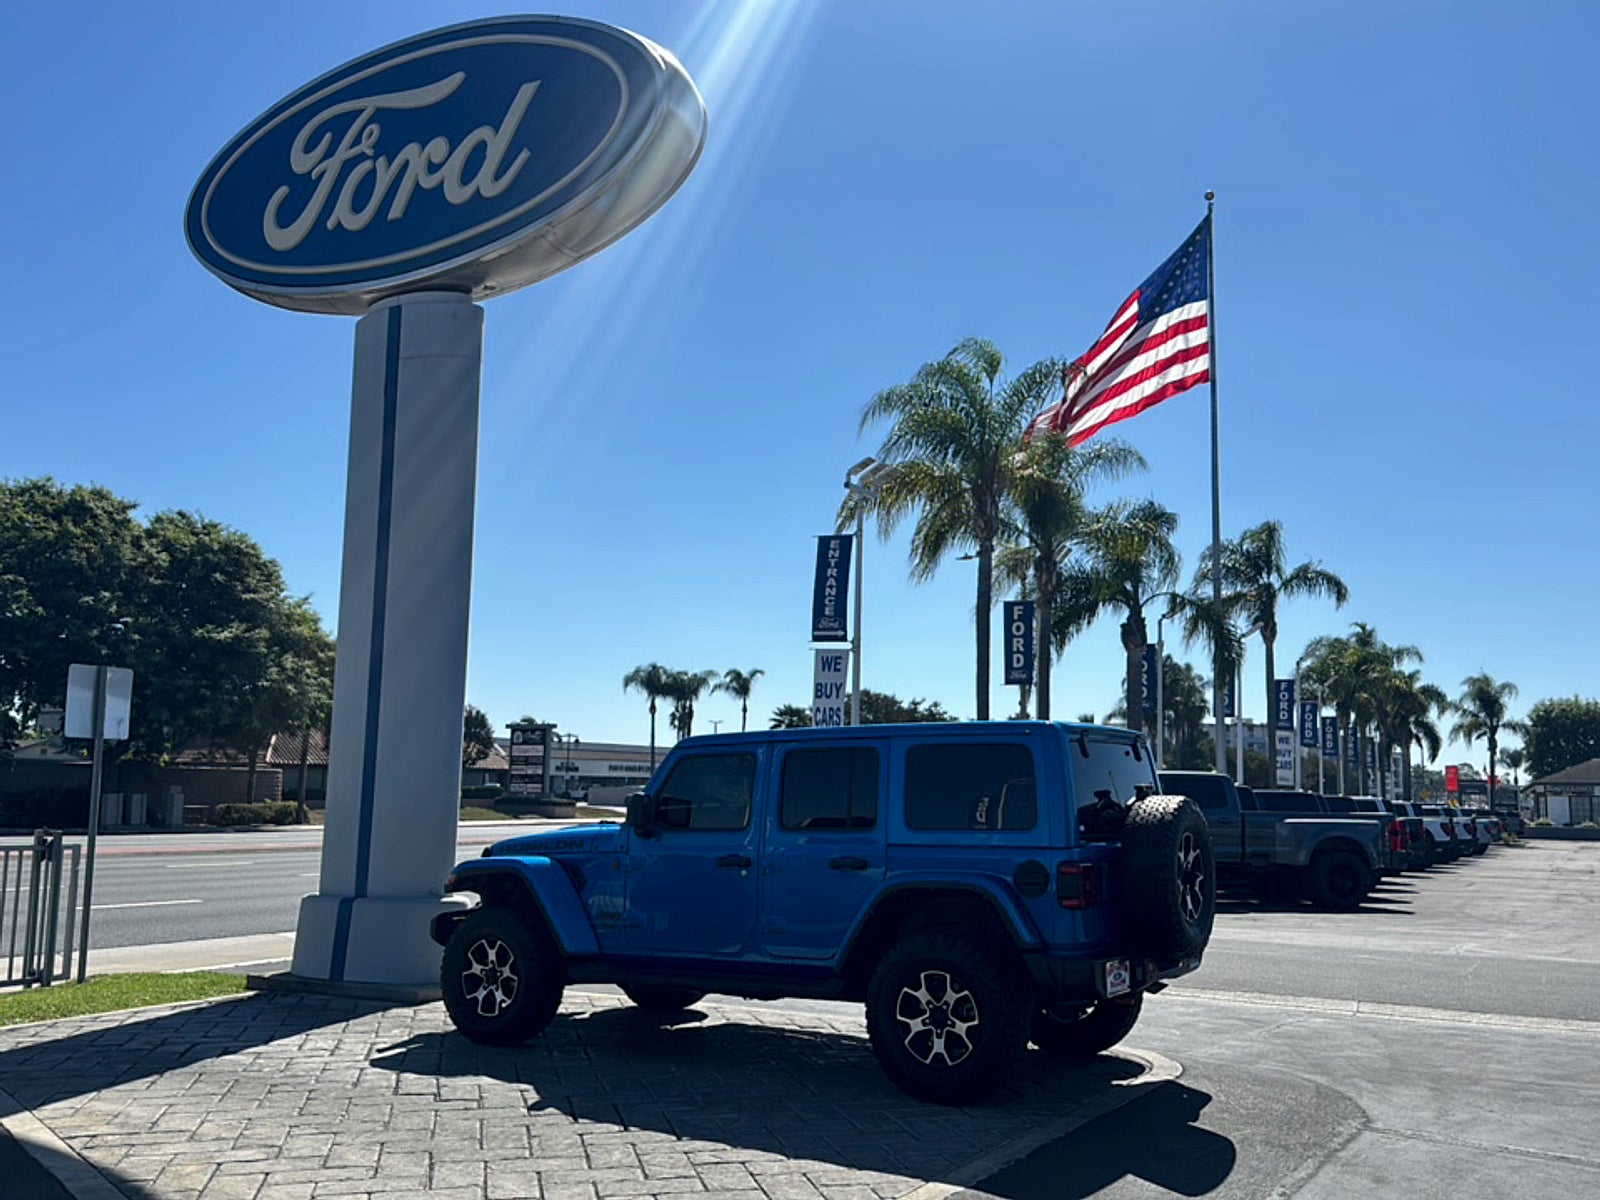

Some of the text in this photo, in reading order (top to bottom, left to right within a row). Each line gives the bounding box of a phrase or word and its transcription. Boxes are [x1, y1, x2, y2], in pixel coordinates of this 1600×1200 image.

[263, 71, 541, 251] Ford
[824, 540, 840, 616] ENTRANCE
[1011, 605, 1025, 669] FORD
[821, 655, 842, 672] WE
[815, 682, 843, 699] BUY
[1279, 681, 1289, 720] FORD
[814, 706, 841, 726] CARS
[1304, 704, 1313, 738] FORD
[1325, 718, 1335, 748] FORD
